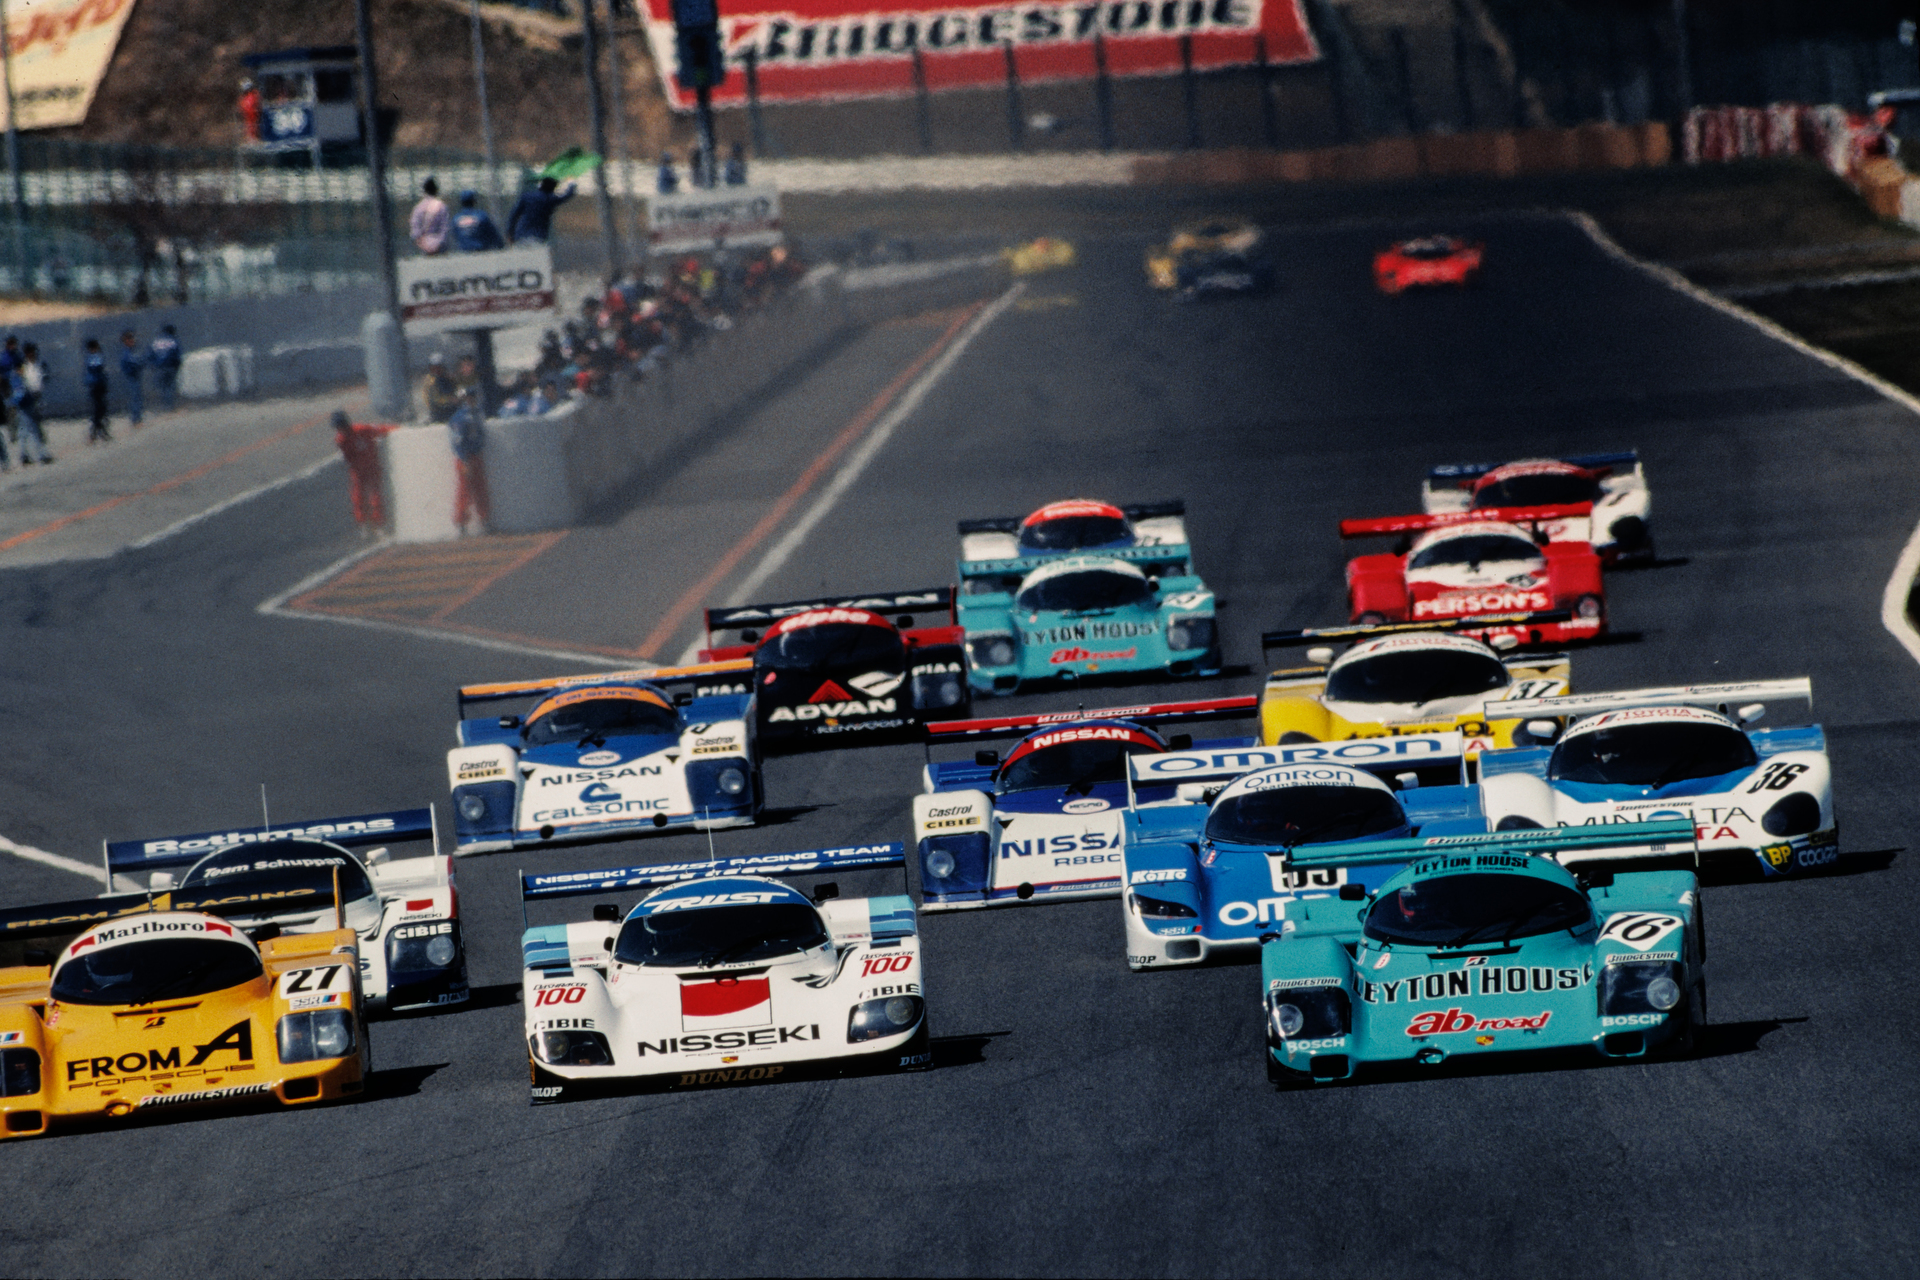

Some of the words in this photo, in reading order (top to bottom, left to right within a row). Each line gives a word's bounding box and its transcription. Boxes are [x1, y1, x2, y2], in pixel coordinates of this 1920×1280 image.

[411, 270, 543, 300] namco
[1414, 592, 1547, 617] PERSON'S
[911, 662, 961, 677] PIAA
[768, 698, 897, 723] ADVAN
[1033, 729, 1131, 749] NISSAN
[460, 759, 499, 772] Castrol
[540, 765, 662, 788] NISSAN
[1747, 762, 1810, 794] 36
[926, 817, 979, 829] CIBIE
[928, 804, 973, 819] Castrol
[144, 818, 395, 854] Rothmans
[535, 870, 626, 885] NISSEKI
[631, 859, 726, 875] TRUST
[729, 852, 818, 866] RACING
[823, 845, 891, 858] TEAM
[1415, 855, 1472, 876] LEYTON
[1476, 855, 1530, 869] HOUSE
[1766, 845, 1791, 866] BP
[203, 863, 249, 879] Team
[253, 857, 347, 871] Schuppan
[643, 890, 790, 914] TRUST
[98, 920, 206, 946] Marlboro
[393, 922, 453, 939] CIBIE
[861, 955, 913, 978] 100
[286, 964, 343, 995] 27
[1353, 969, 1471, 1003] LEYTON
[534, 987, 587, 1008] 100
[859, 983, 920, 1000] CIBIE
[534, 1018, 596, 1030] CIBIE
[1405, 1009, 1552, 1036] ab-road
[1602, 1015, 1663, 1028] BOSCH
[66, 1046, 182, 1082] FROM
[184, 1017, 254, 1067] A
[637, 1023, 821, 1057] NISSEKI
[1285, 1038, 1345, 1054] BOSCH
[68, 1063, 256, 1092] PORSCHE
[678, 1065, 785, 1087] DUNLOP
